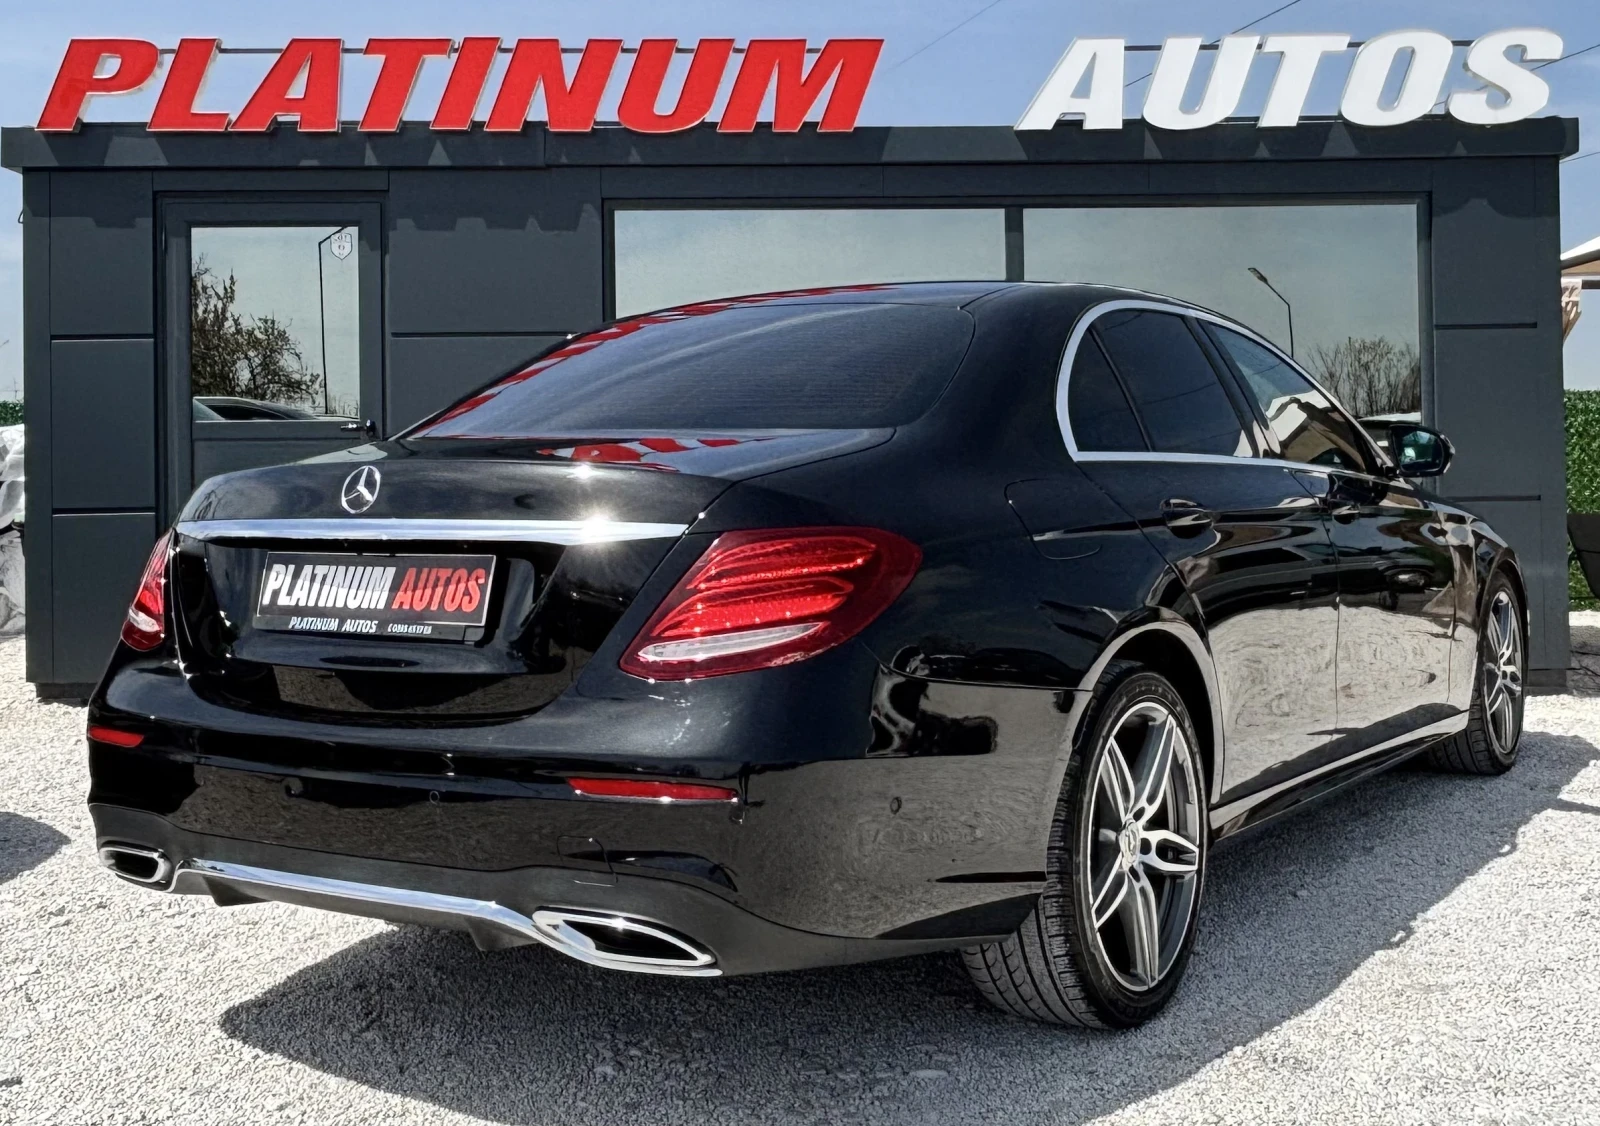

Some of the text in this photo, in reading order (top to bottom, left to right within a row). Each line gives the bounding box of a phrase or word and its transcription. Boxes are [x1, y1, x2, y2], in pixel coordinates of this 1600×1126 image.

[35, 28, 1564, 133] PLATINUM AUTOS
[262, 564, 486, 613] PLATINUM AUTOS
[288, 616, 338, 632] PLATINUM
[342, 619, 378, 633] AUTOS
